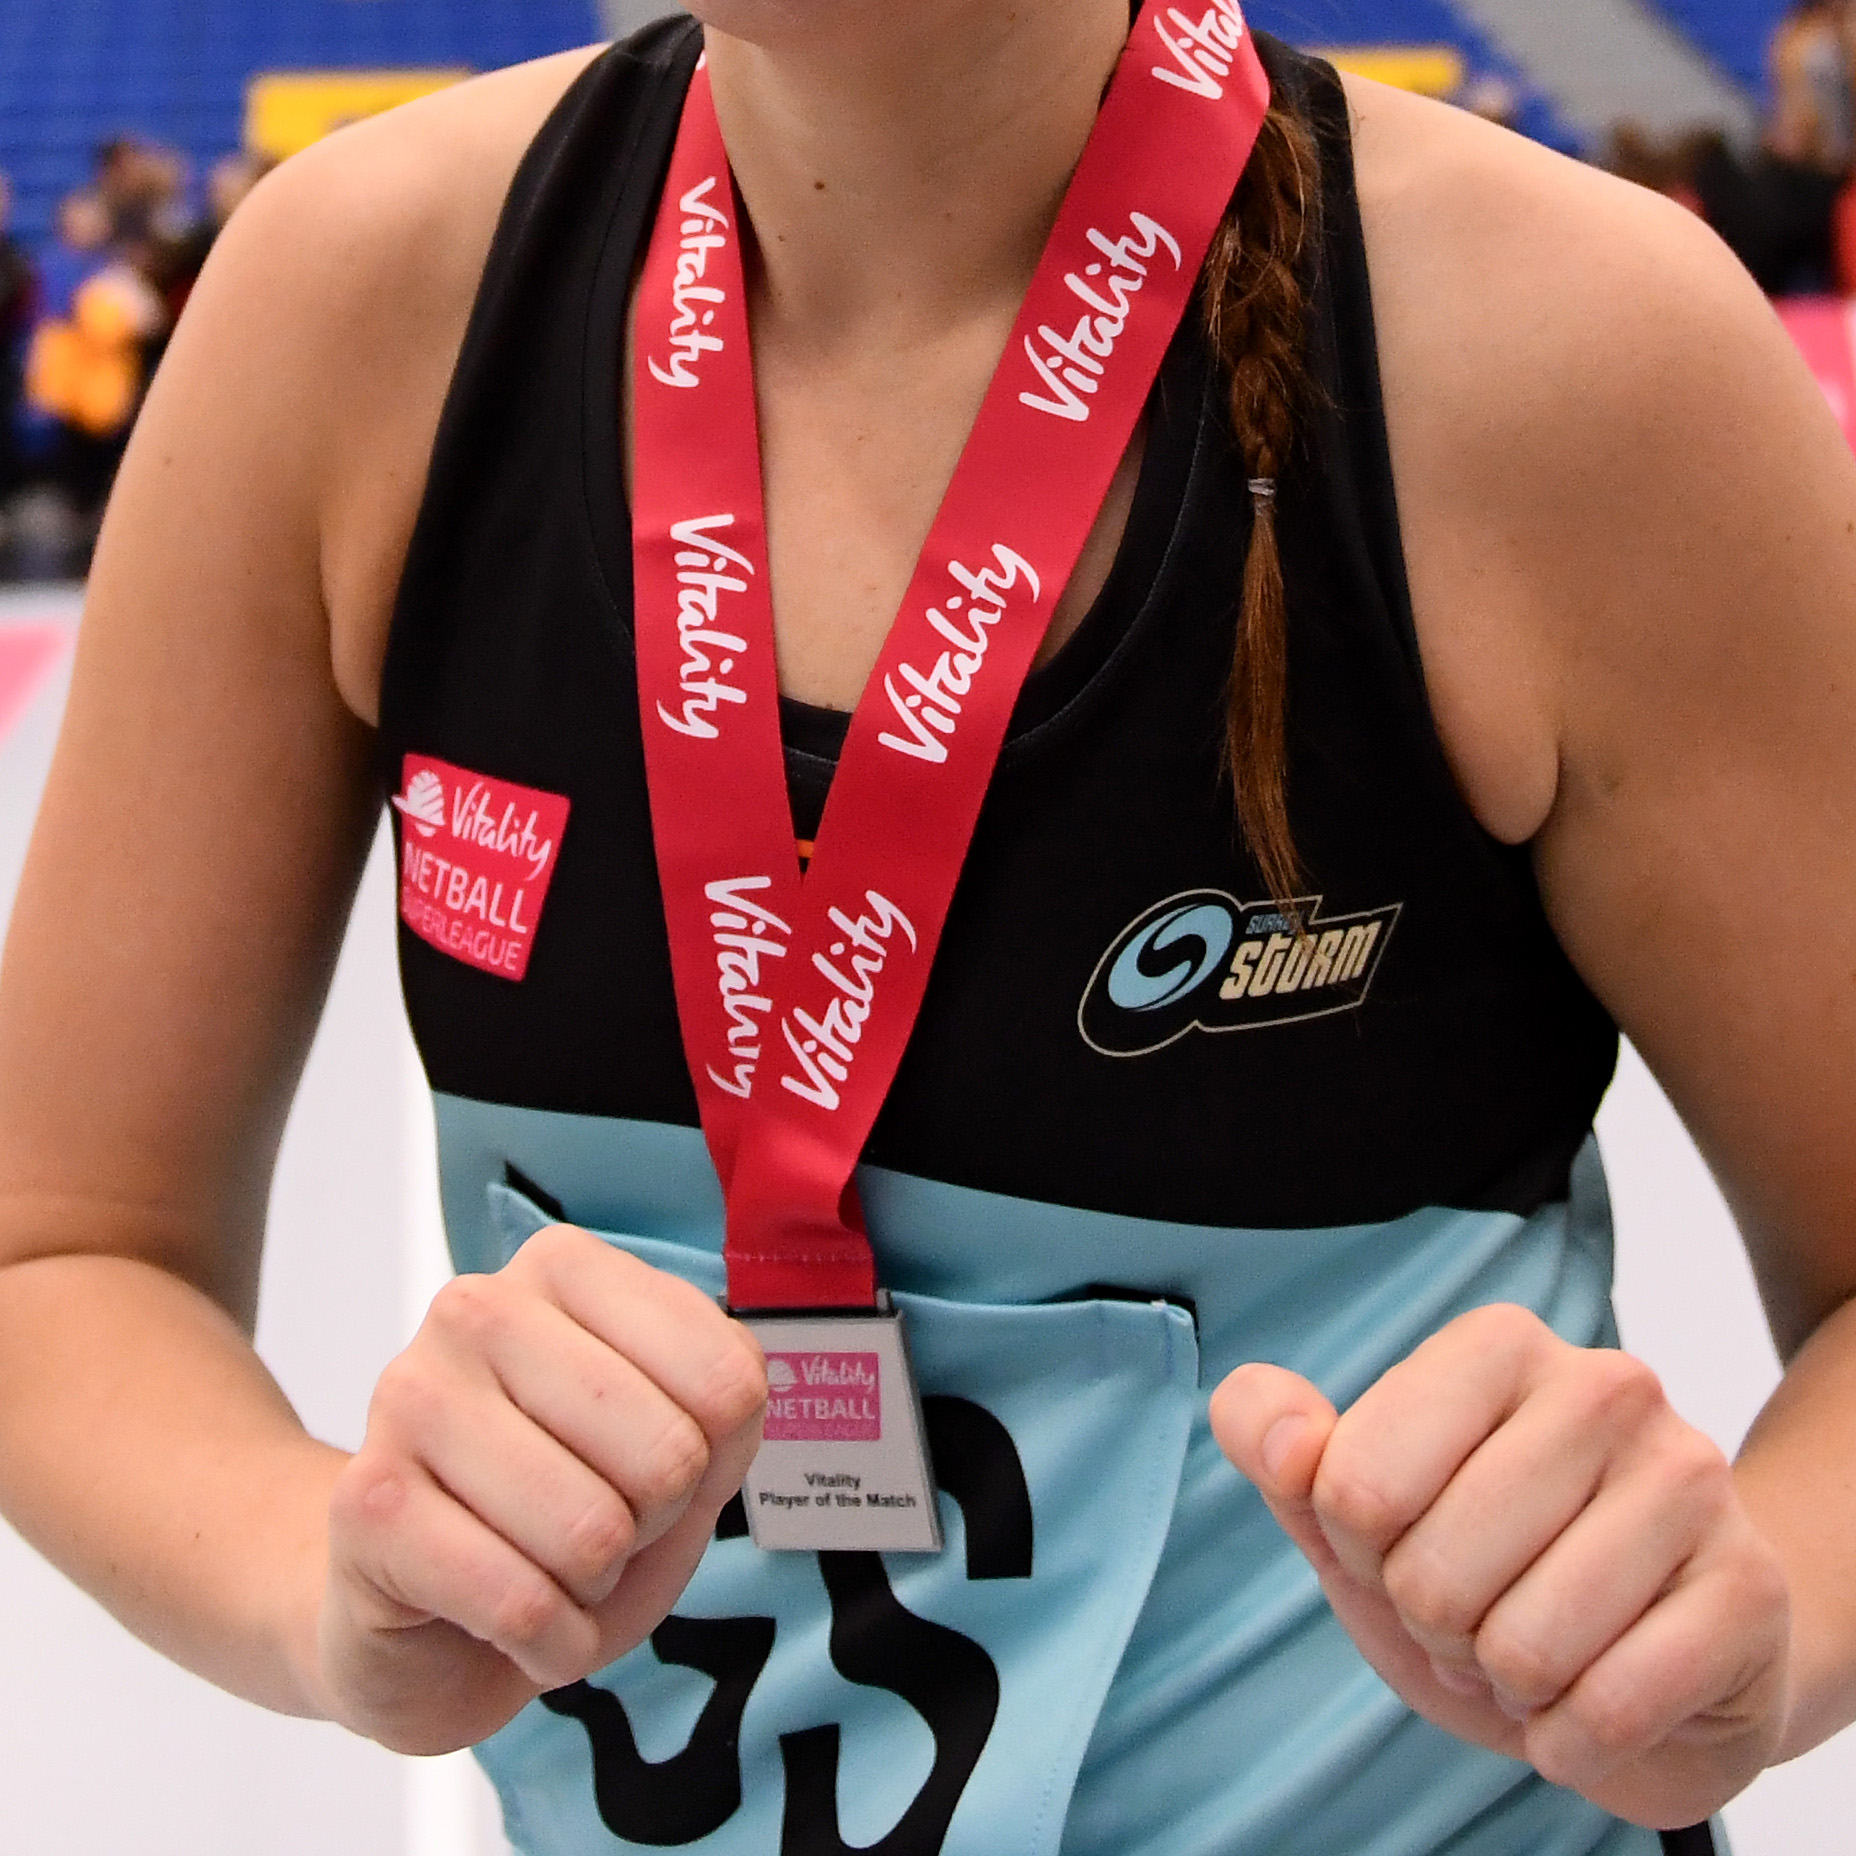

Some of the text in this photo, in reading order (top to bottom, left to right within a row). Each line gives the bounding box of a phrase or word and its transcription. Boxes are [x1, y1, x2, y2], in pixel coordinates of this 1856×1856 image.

[647, 175, 730, 383] Vitality
[1018, 210, 1182, 423] Vitality
[656, 512, 756, 740] Vitality
[877, 542, 1042, 765] Vitality
[451, 780, 552, 882] Vitality
[402, 886, 523, 971] ERLEAGUE
[403, 841, 528, 935] NETBALL
[781, 888, 918, 1112] Vitality
[766, 1397, 876, 1420] NETBALL
[800, 1354, 876, 1394] Vitality
[758, 1492, 917, 1509] Player of the Match
[803, 1472, 862, 1491] Vitality
